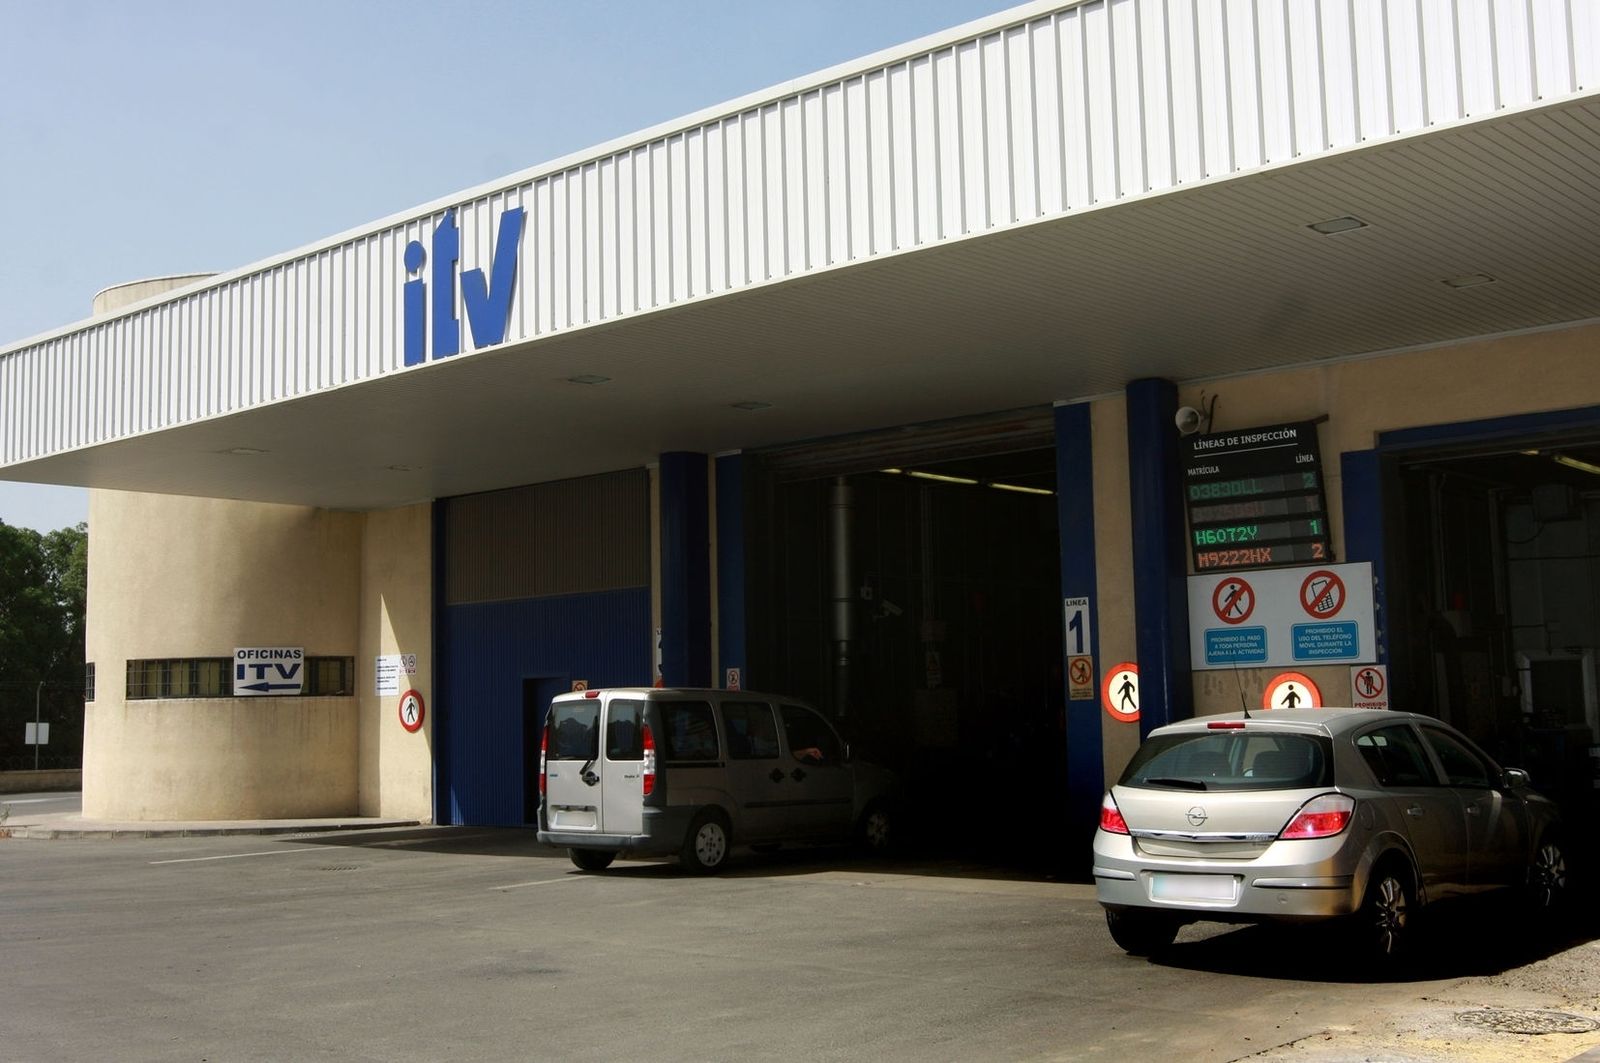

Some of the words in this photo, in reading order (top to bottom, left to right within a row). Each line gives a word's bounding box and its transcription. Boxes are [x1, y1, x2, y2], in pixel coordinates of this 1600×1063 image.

[1193, 437, 1225, 450] LÍNEAS
[1227, 437, 1239, 446] DE
[1241, 428, 1297, 445] INSPECCIÓN
[1296, 453, 1314, 463] LÍNEA
[1187, 465, 1219, 476] MATRÍCULA
[1302, 472, 1315, 488] 2
[1310, 519, 1319, 535] 1
[1312, 543, 1324, 559] 2
[1066, 599, 1087, 607] LINEA
[1069, 610, 1084, 653] 1
[237, 650, 302, 659] OFICINAS
[237, 664, 301, 679] ITV
